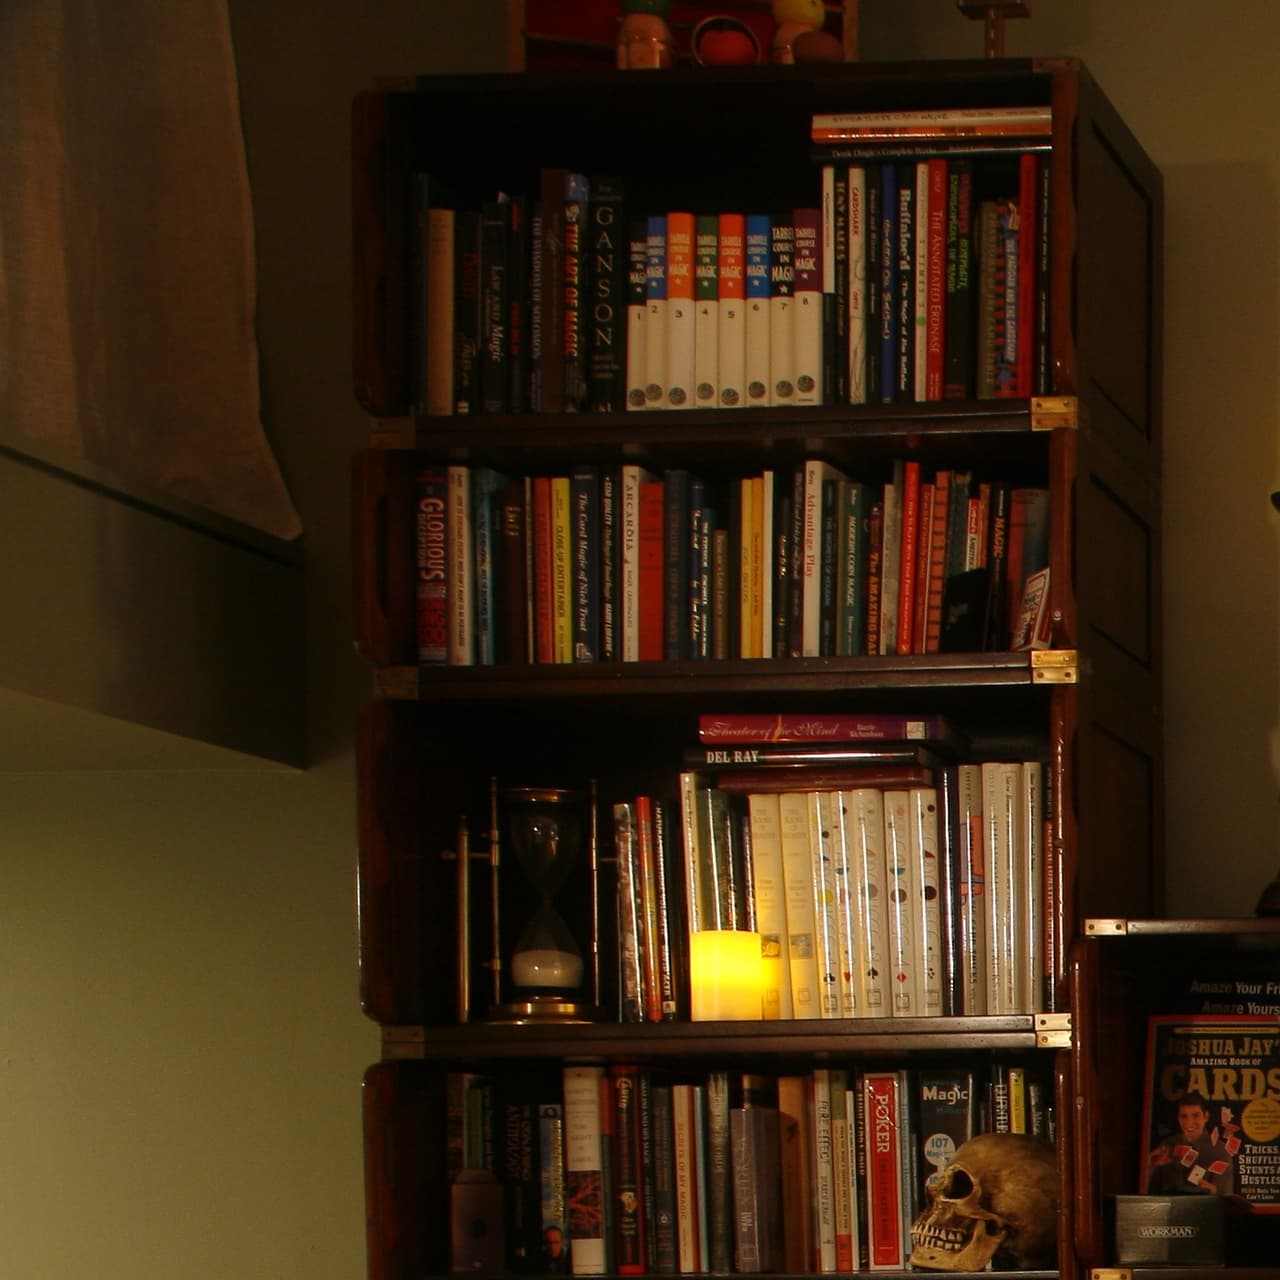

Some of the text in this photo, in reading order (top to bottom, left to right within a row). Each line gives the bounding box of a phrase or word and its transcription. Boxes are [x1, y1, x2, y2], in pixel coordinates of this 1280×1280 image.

[565, 225, 578, 358] THE ART OF MAGIC
[594, 207, 614, 346] GANSON
[929, 212, 943, 353] THE ANNOTATED ERDNASE
[421, 499, 444, 580] GLORIOUS
[807, 493, 817, 550] Advantage
[806, 555, 816, 577] Play
[875, 1094, 890, 1153] POKER
